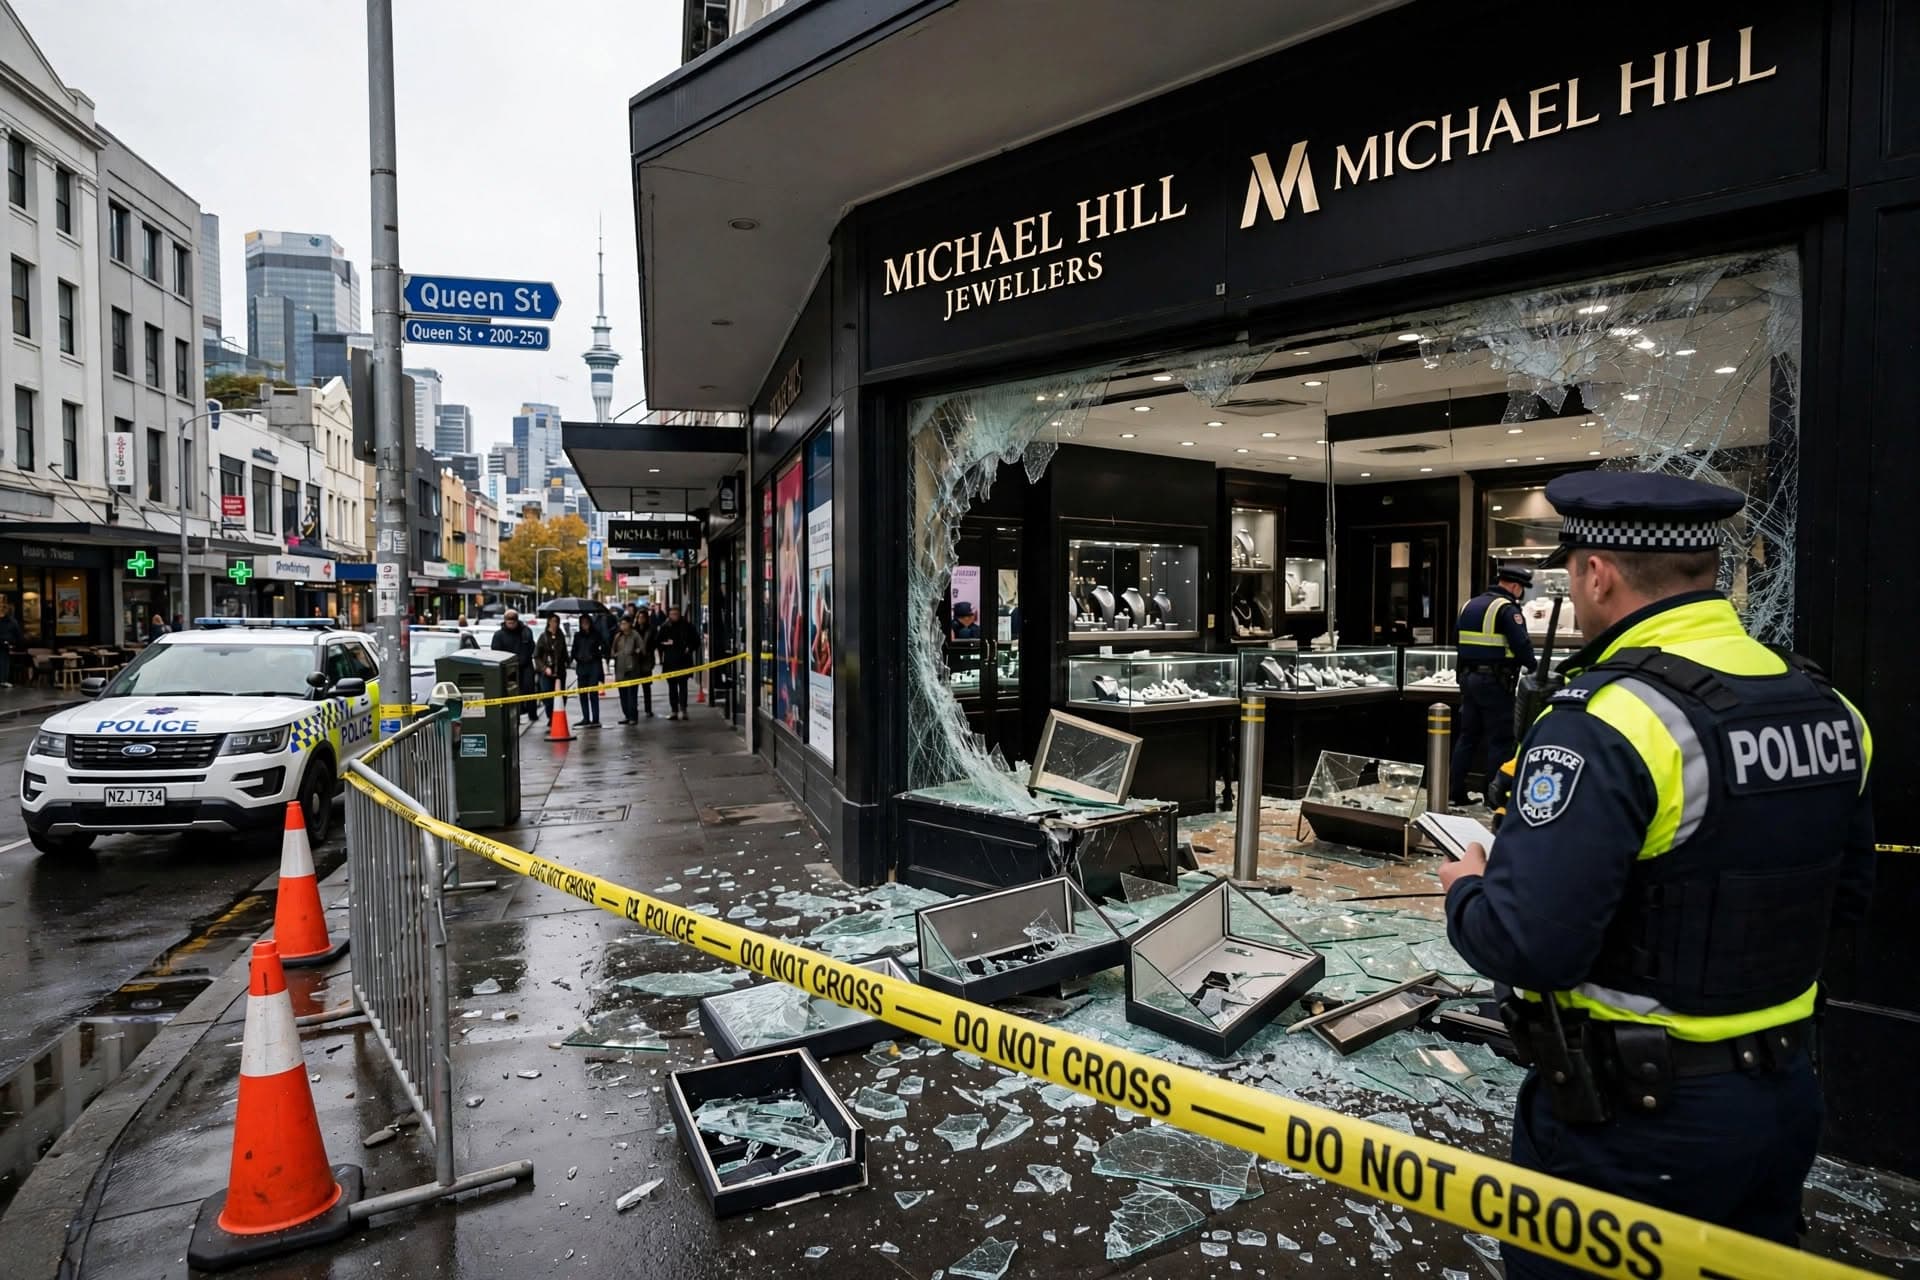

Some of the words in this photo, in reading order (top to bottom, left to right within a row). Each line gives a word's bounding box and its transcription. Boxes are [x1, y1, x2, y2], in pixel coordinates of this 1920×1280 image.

[1333, 77, 1600, 191] MICHAEL
[1619, 25, 1777, 116] HILL
[883, 211, 1063, 296] MICHAEL
[1076, 174, 1188, 244] HILL
[420, 282, 504, 311] Queen
[514, 287, 542, 313] St
[943, 251, 1103, 321] JEWELLERS
[412, 323, 454, 341] Queen
[458, 326, 472, 342] St
[489, 328, 543, 346] 200-250
[95, 719, 200, 733] POLICE
[341, 715, 373, 746] POLICE
[1727, 719, 1857, 785] POLICE
[1528, 750, 1542, 763] NZ
[1541, 749, 1580, 771] POLICE
[108, 790, 134, 803] NZJ
[137, 790, 162, 803] 734
[645, 903, 697, 945] POLICE
[740, 938, 765, 973] DO
[769, 949, 807, 988] NOT
[812, 962, 884, 1016] CROSS
[954, 1010, 990, 1054] DO
[999, 1024, 1056, 1077] NOT
[1061, 1047, 1172, 1117] CROSS
[1285, 1114, 1344, 1176] DO
[1360, 1136, 1457, 1211] NOT
[1470, 1174, 1664, 1280] CROSS
